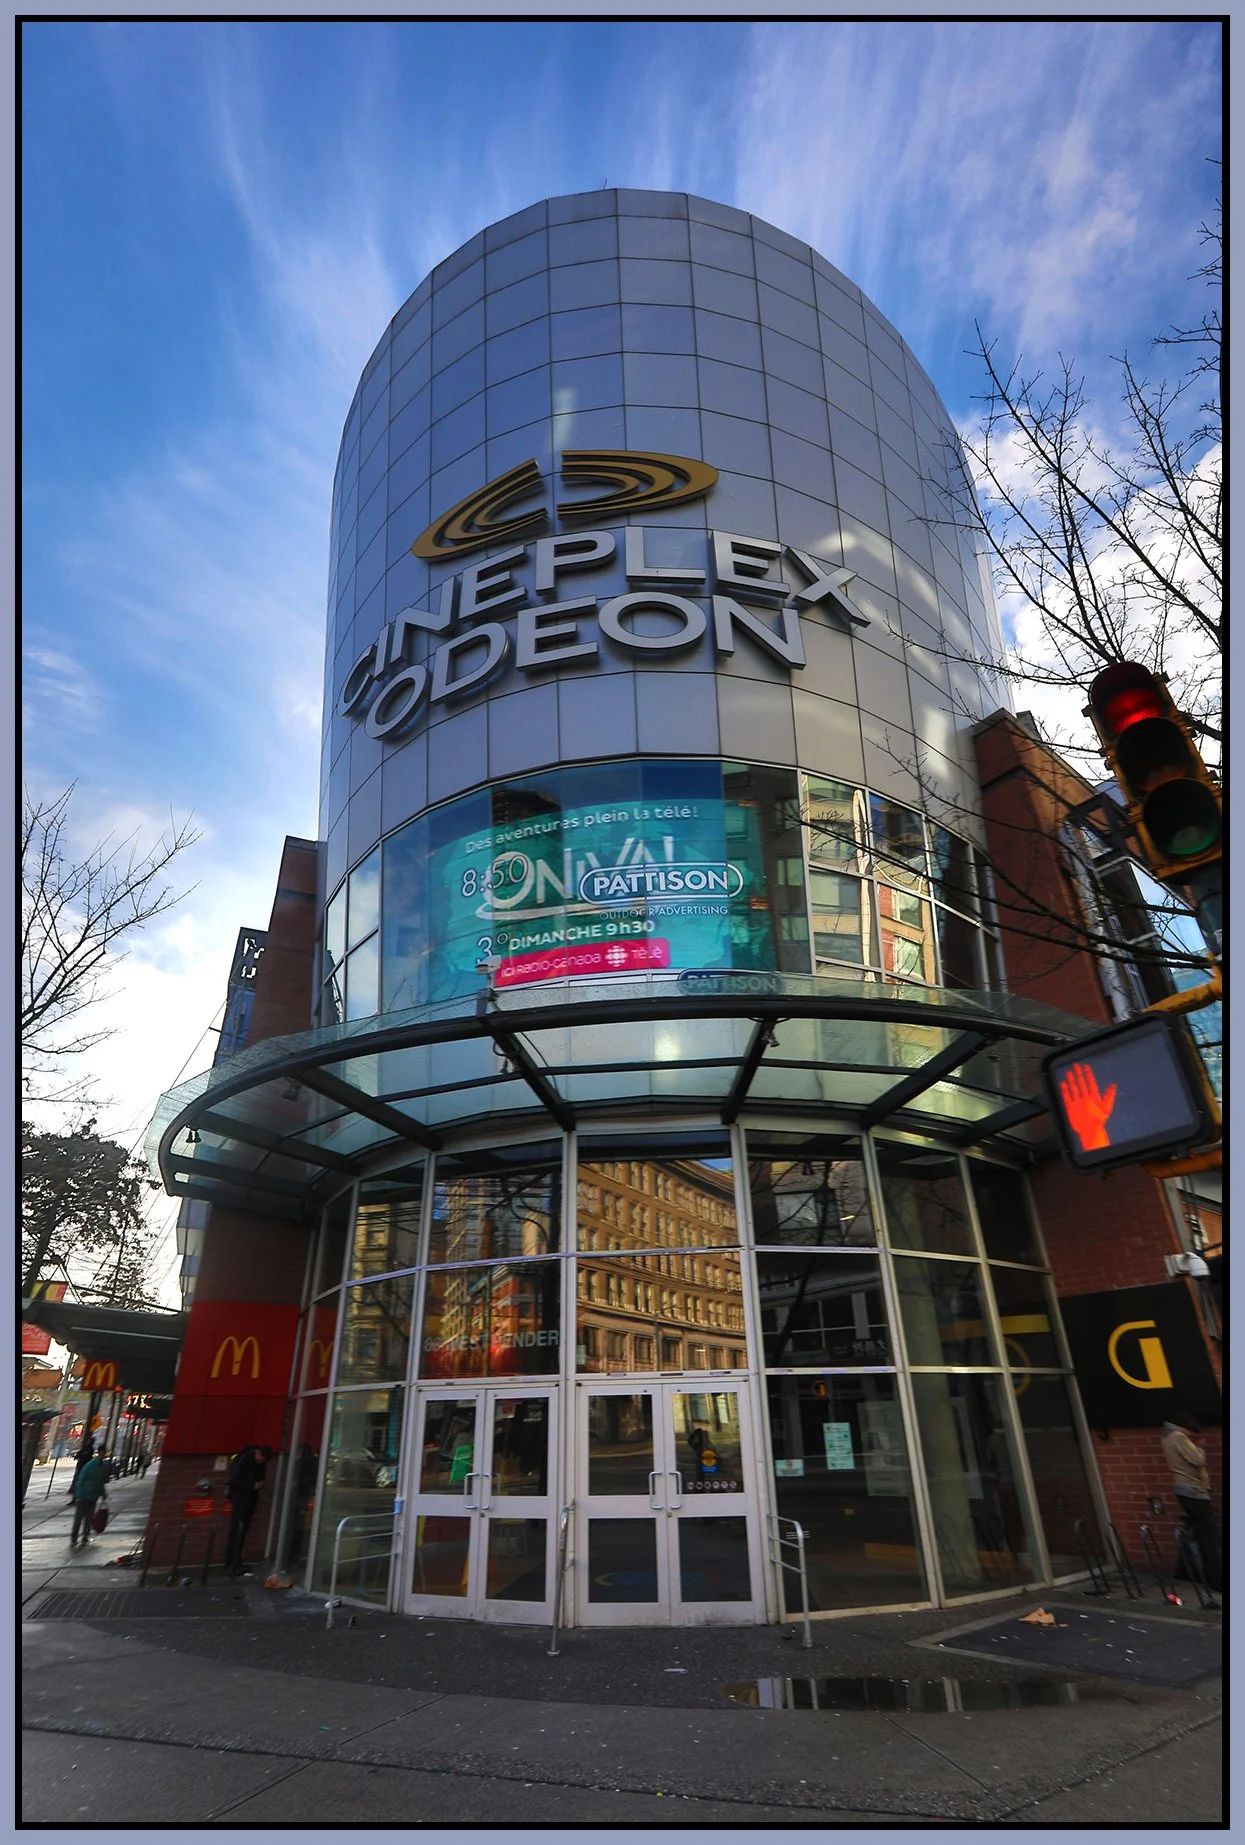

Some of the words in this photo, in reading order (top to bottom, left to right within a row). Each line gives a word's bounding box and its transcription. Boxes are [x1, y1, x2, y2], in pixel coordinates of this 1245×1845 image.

[338, 526, 871, 718] CINEPLEX
[364, 592, 806, 741] ODEON
[465, 838, 492, 854] Des
[495, 817, 580, 845] aventures
[583, 809, 629, 829] plein
[633, 807, 650, 820] la
[653, 804, 699, 819] télé!
[461, 855, 530, 898] 8:50
[593, 869, 729, 897] PATTISON
[657, 904, 729, 917] ADVERTISING
[509, 924, 602, 951] DIMANCHE
[605, 919, 656, 936] 9h30
